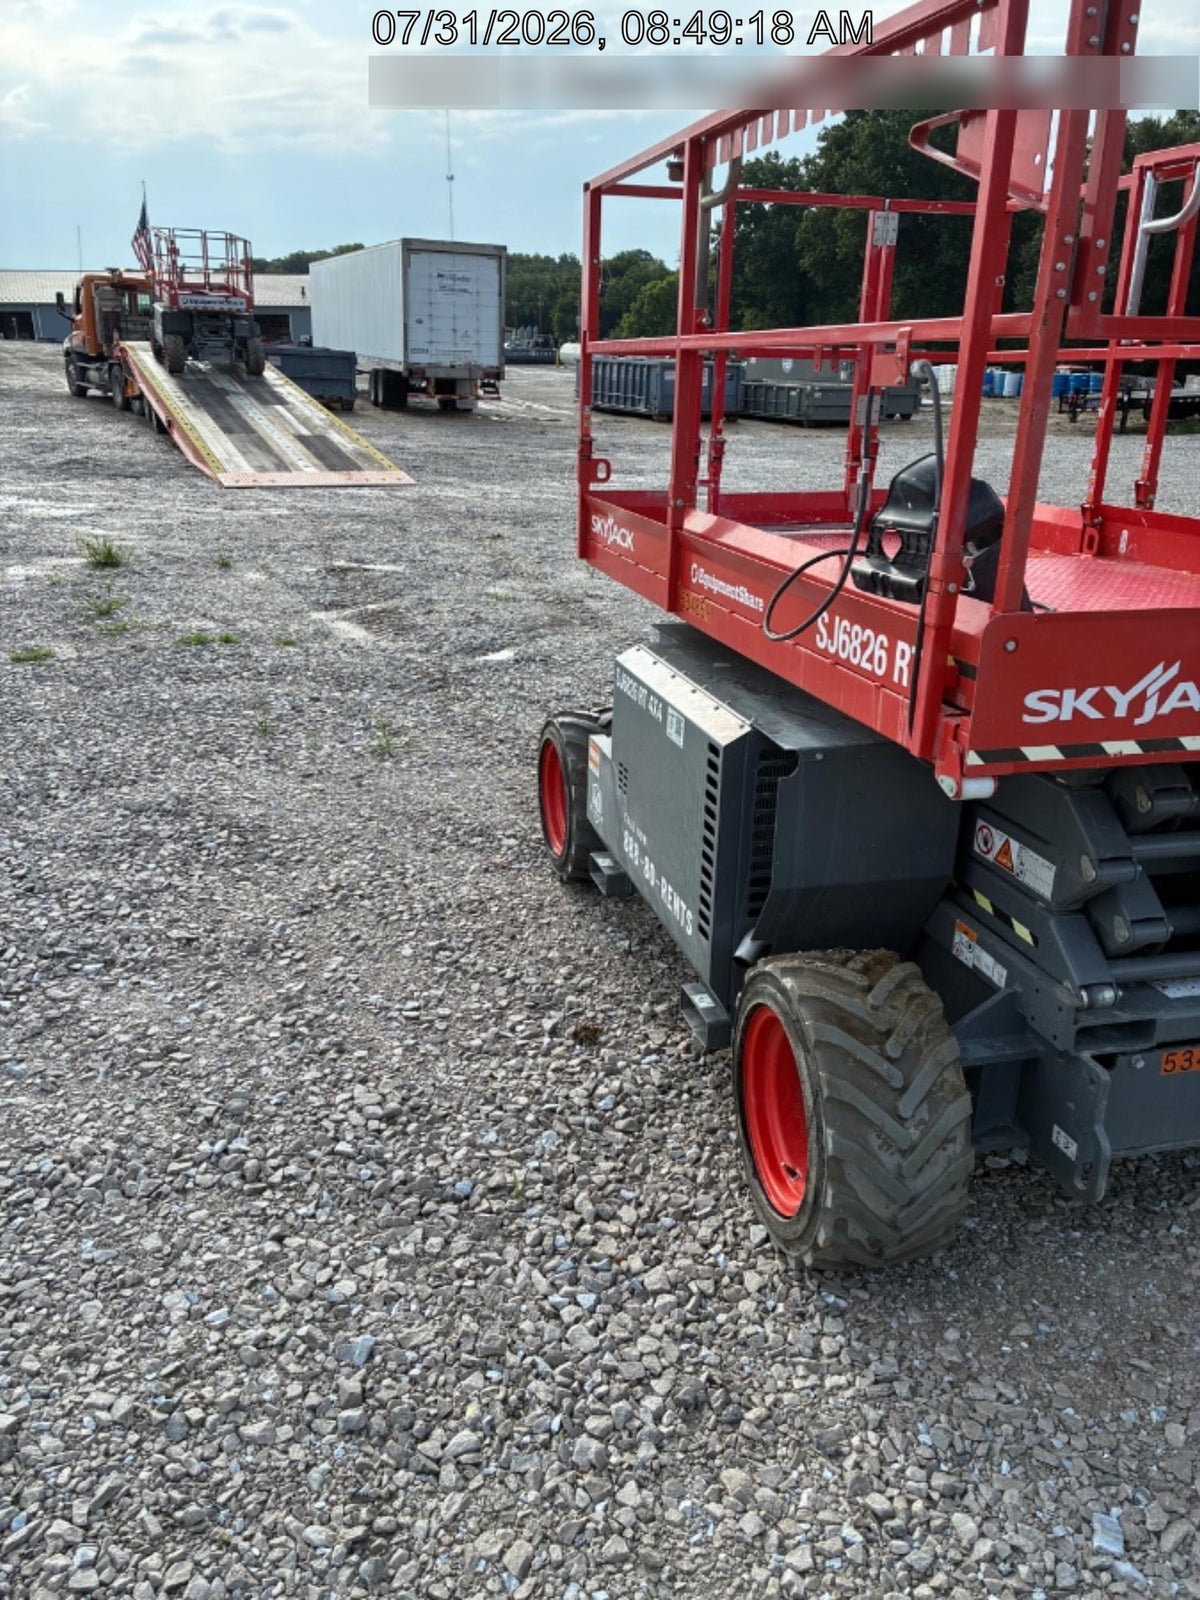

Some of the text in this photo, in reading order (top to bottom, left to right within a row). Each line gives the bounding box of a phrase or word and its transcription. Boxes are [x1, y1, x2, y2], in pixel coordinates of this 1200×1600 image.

[591, 512, 634, 552] SKYJACK
[698, 566, 765, 613] EquipmentShare
[815, 610, 888, 677] SJ6826
[1163, 1049, 1200, 1073] 53
